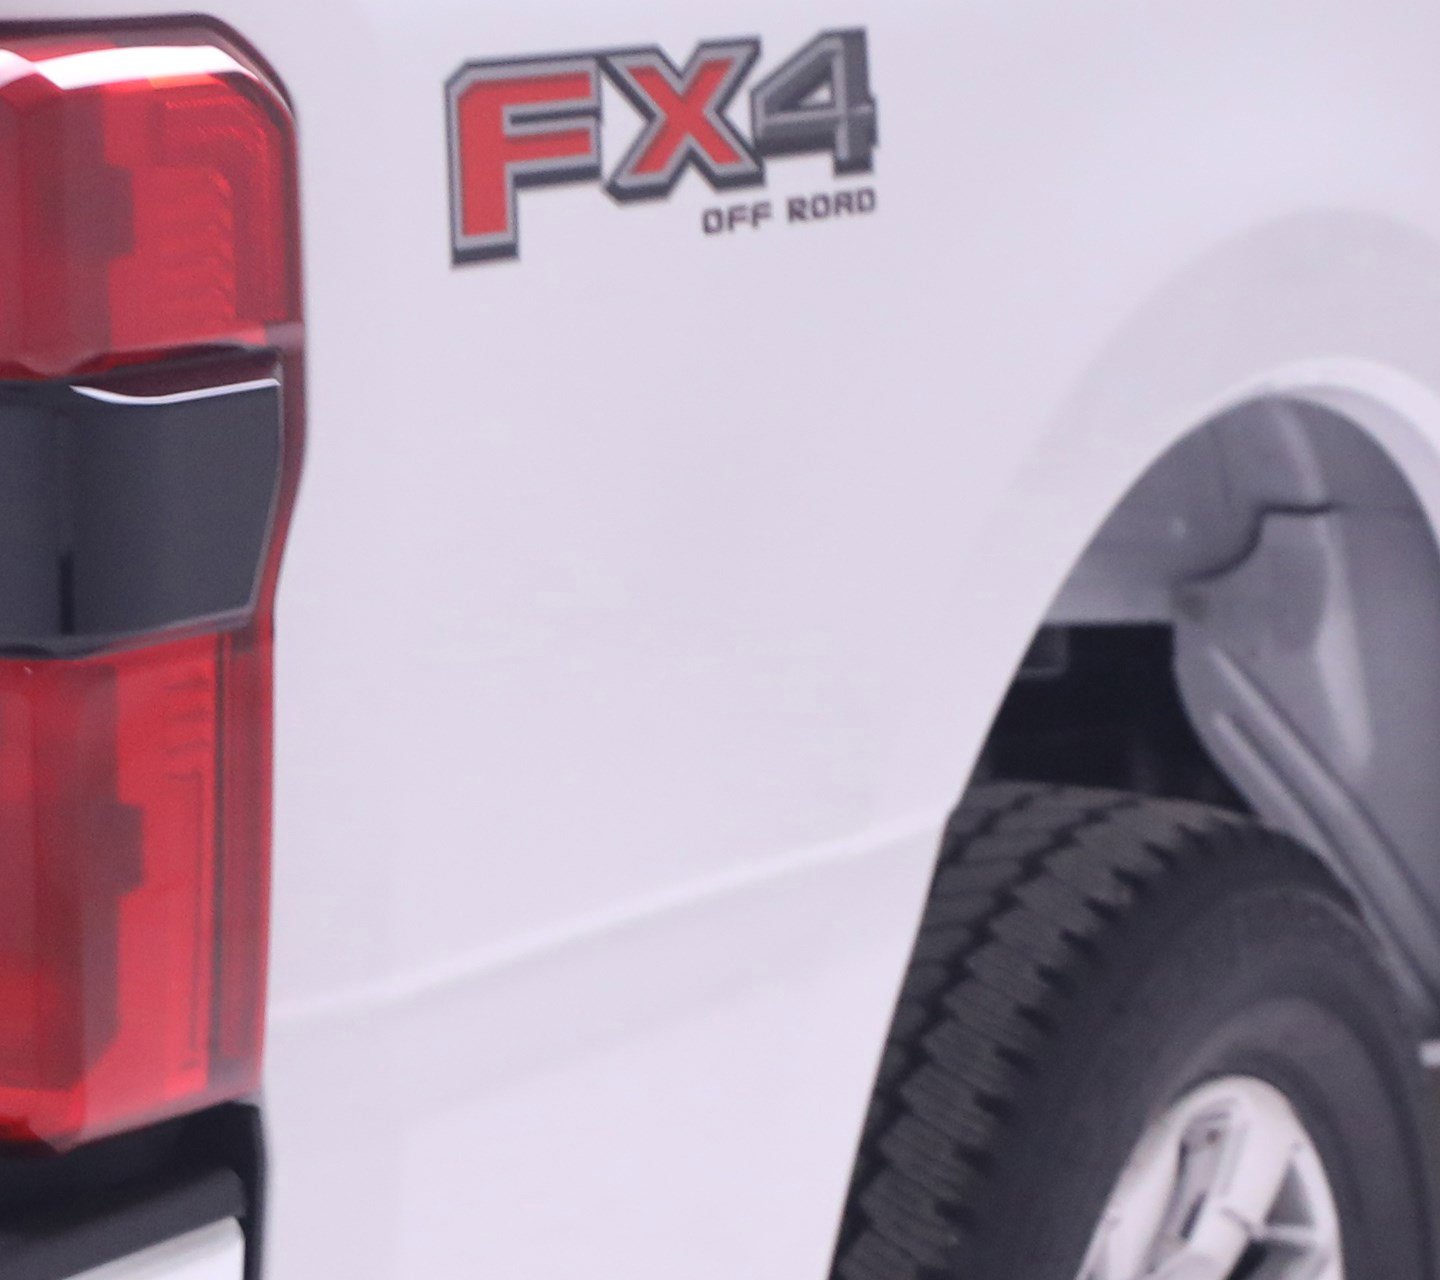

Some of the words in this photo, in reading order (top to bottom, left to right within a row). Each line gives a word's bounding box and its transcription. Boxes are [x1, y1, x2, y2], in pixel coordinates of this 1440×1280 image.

[444, 26, 877, 269] FX4
[702, 203, 774, 236] OFF
[787, 186, 877, 227] ROAD
